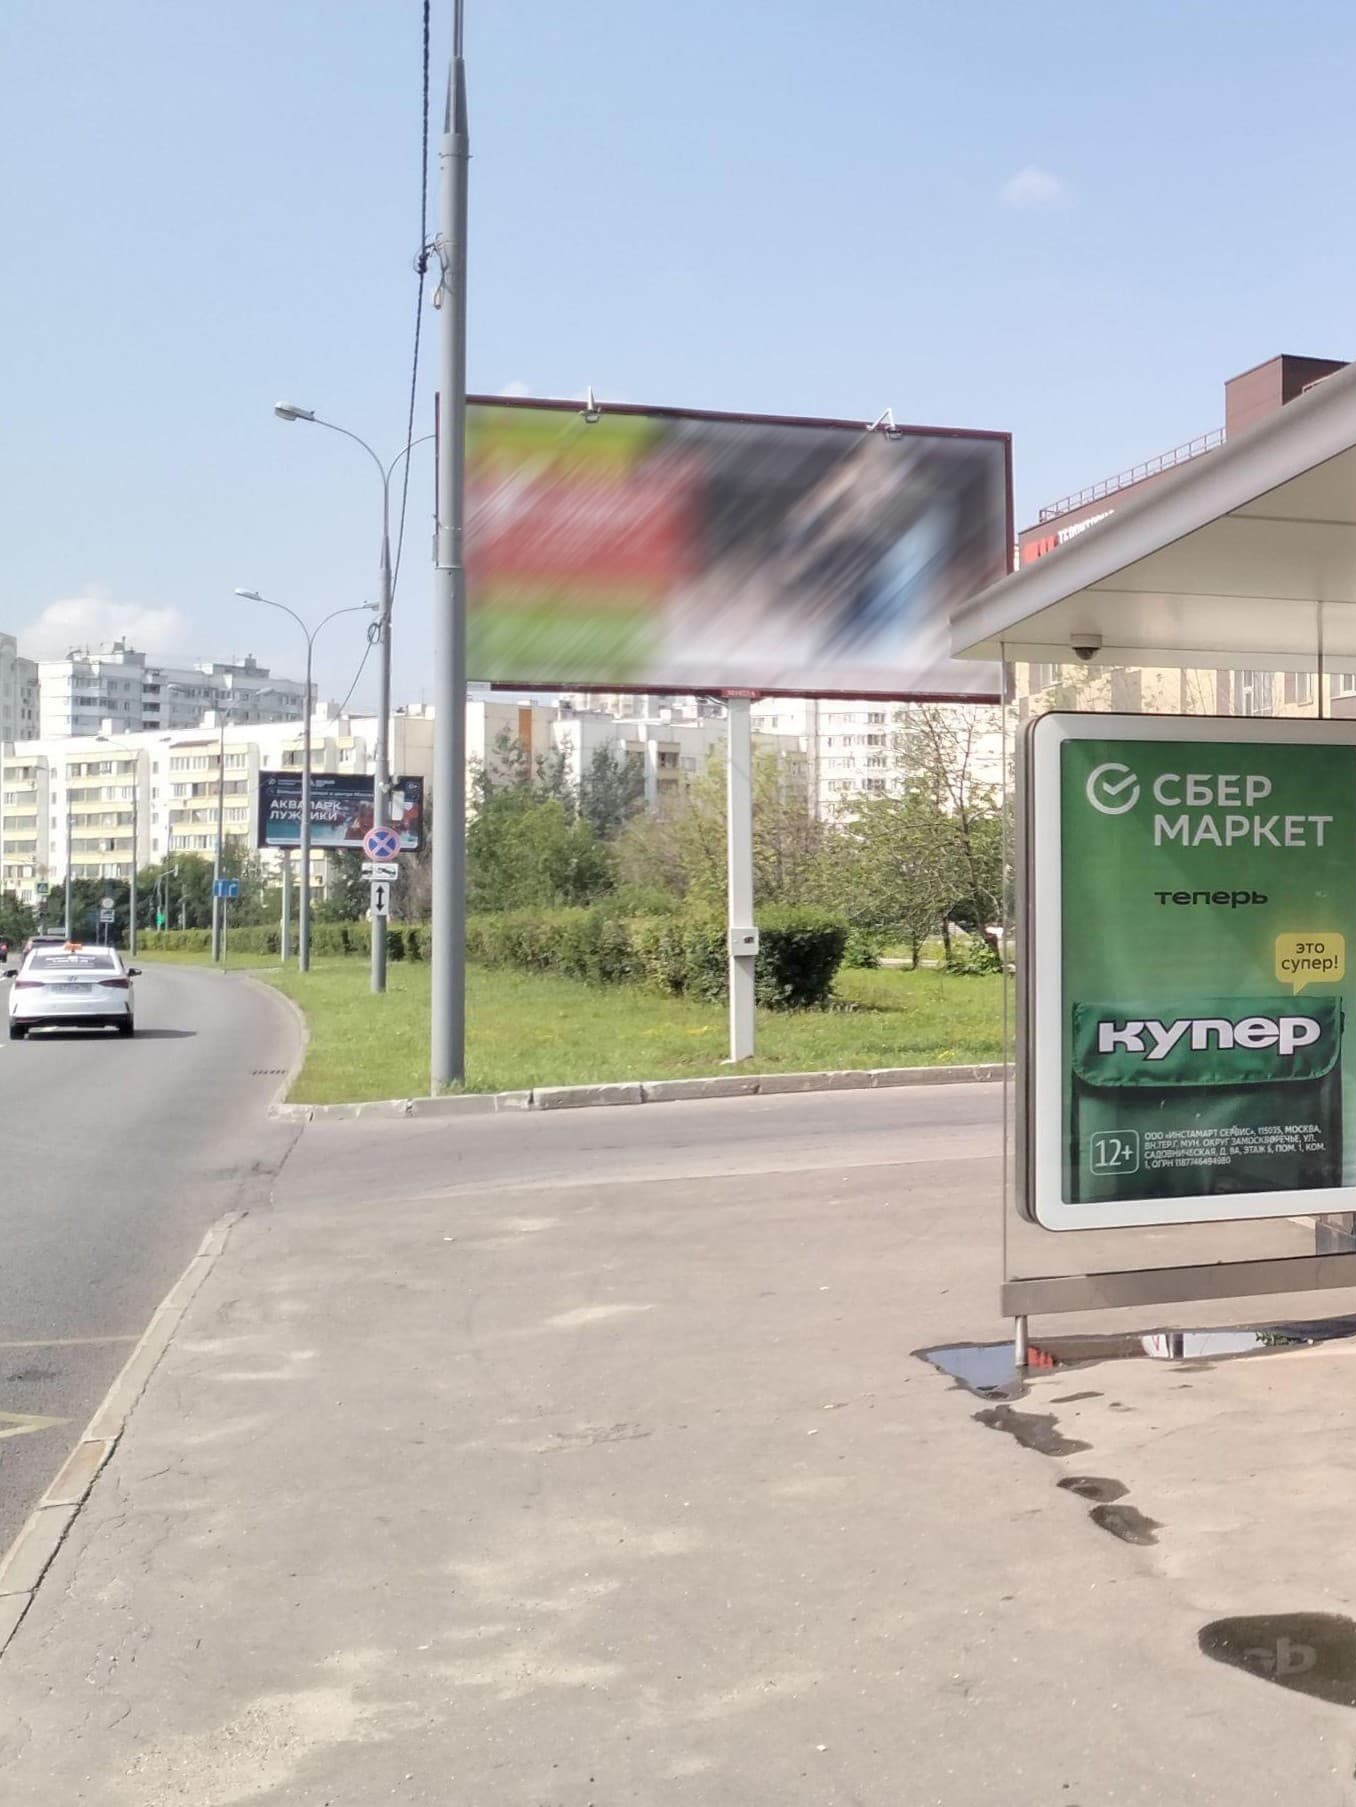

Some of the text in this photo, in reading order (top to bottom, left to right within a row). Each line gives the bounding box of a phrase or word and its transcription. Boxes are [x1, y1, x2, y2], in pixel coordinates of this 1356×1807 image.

[1152, 773, 1272, 807] СБЕР
[270, 810, 337, 820] ЛУЖИКИ
[1153, 814, 1334, 848] МАРКЕТ
[1154, 891, 1269, 910] теперь
[1295, 941, 1326, 955] это
[1281, 955, 1339, 974] супер!
[1097, 1015, 1321, 1061] купер
[1144, 1131, 1164, 1141] ООО
[1095, 1138, 1134, 1168] 12+
